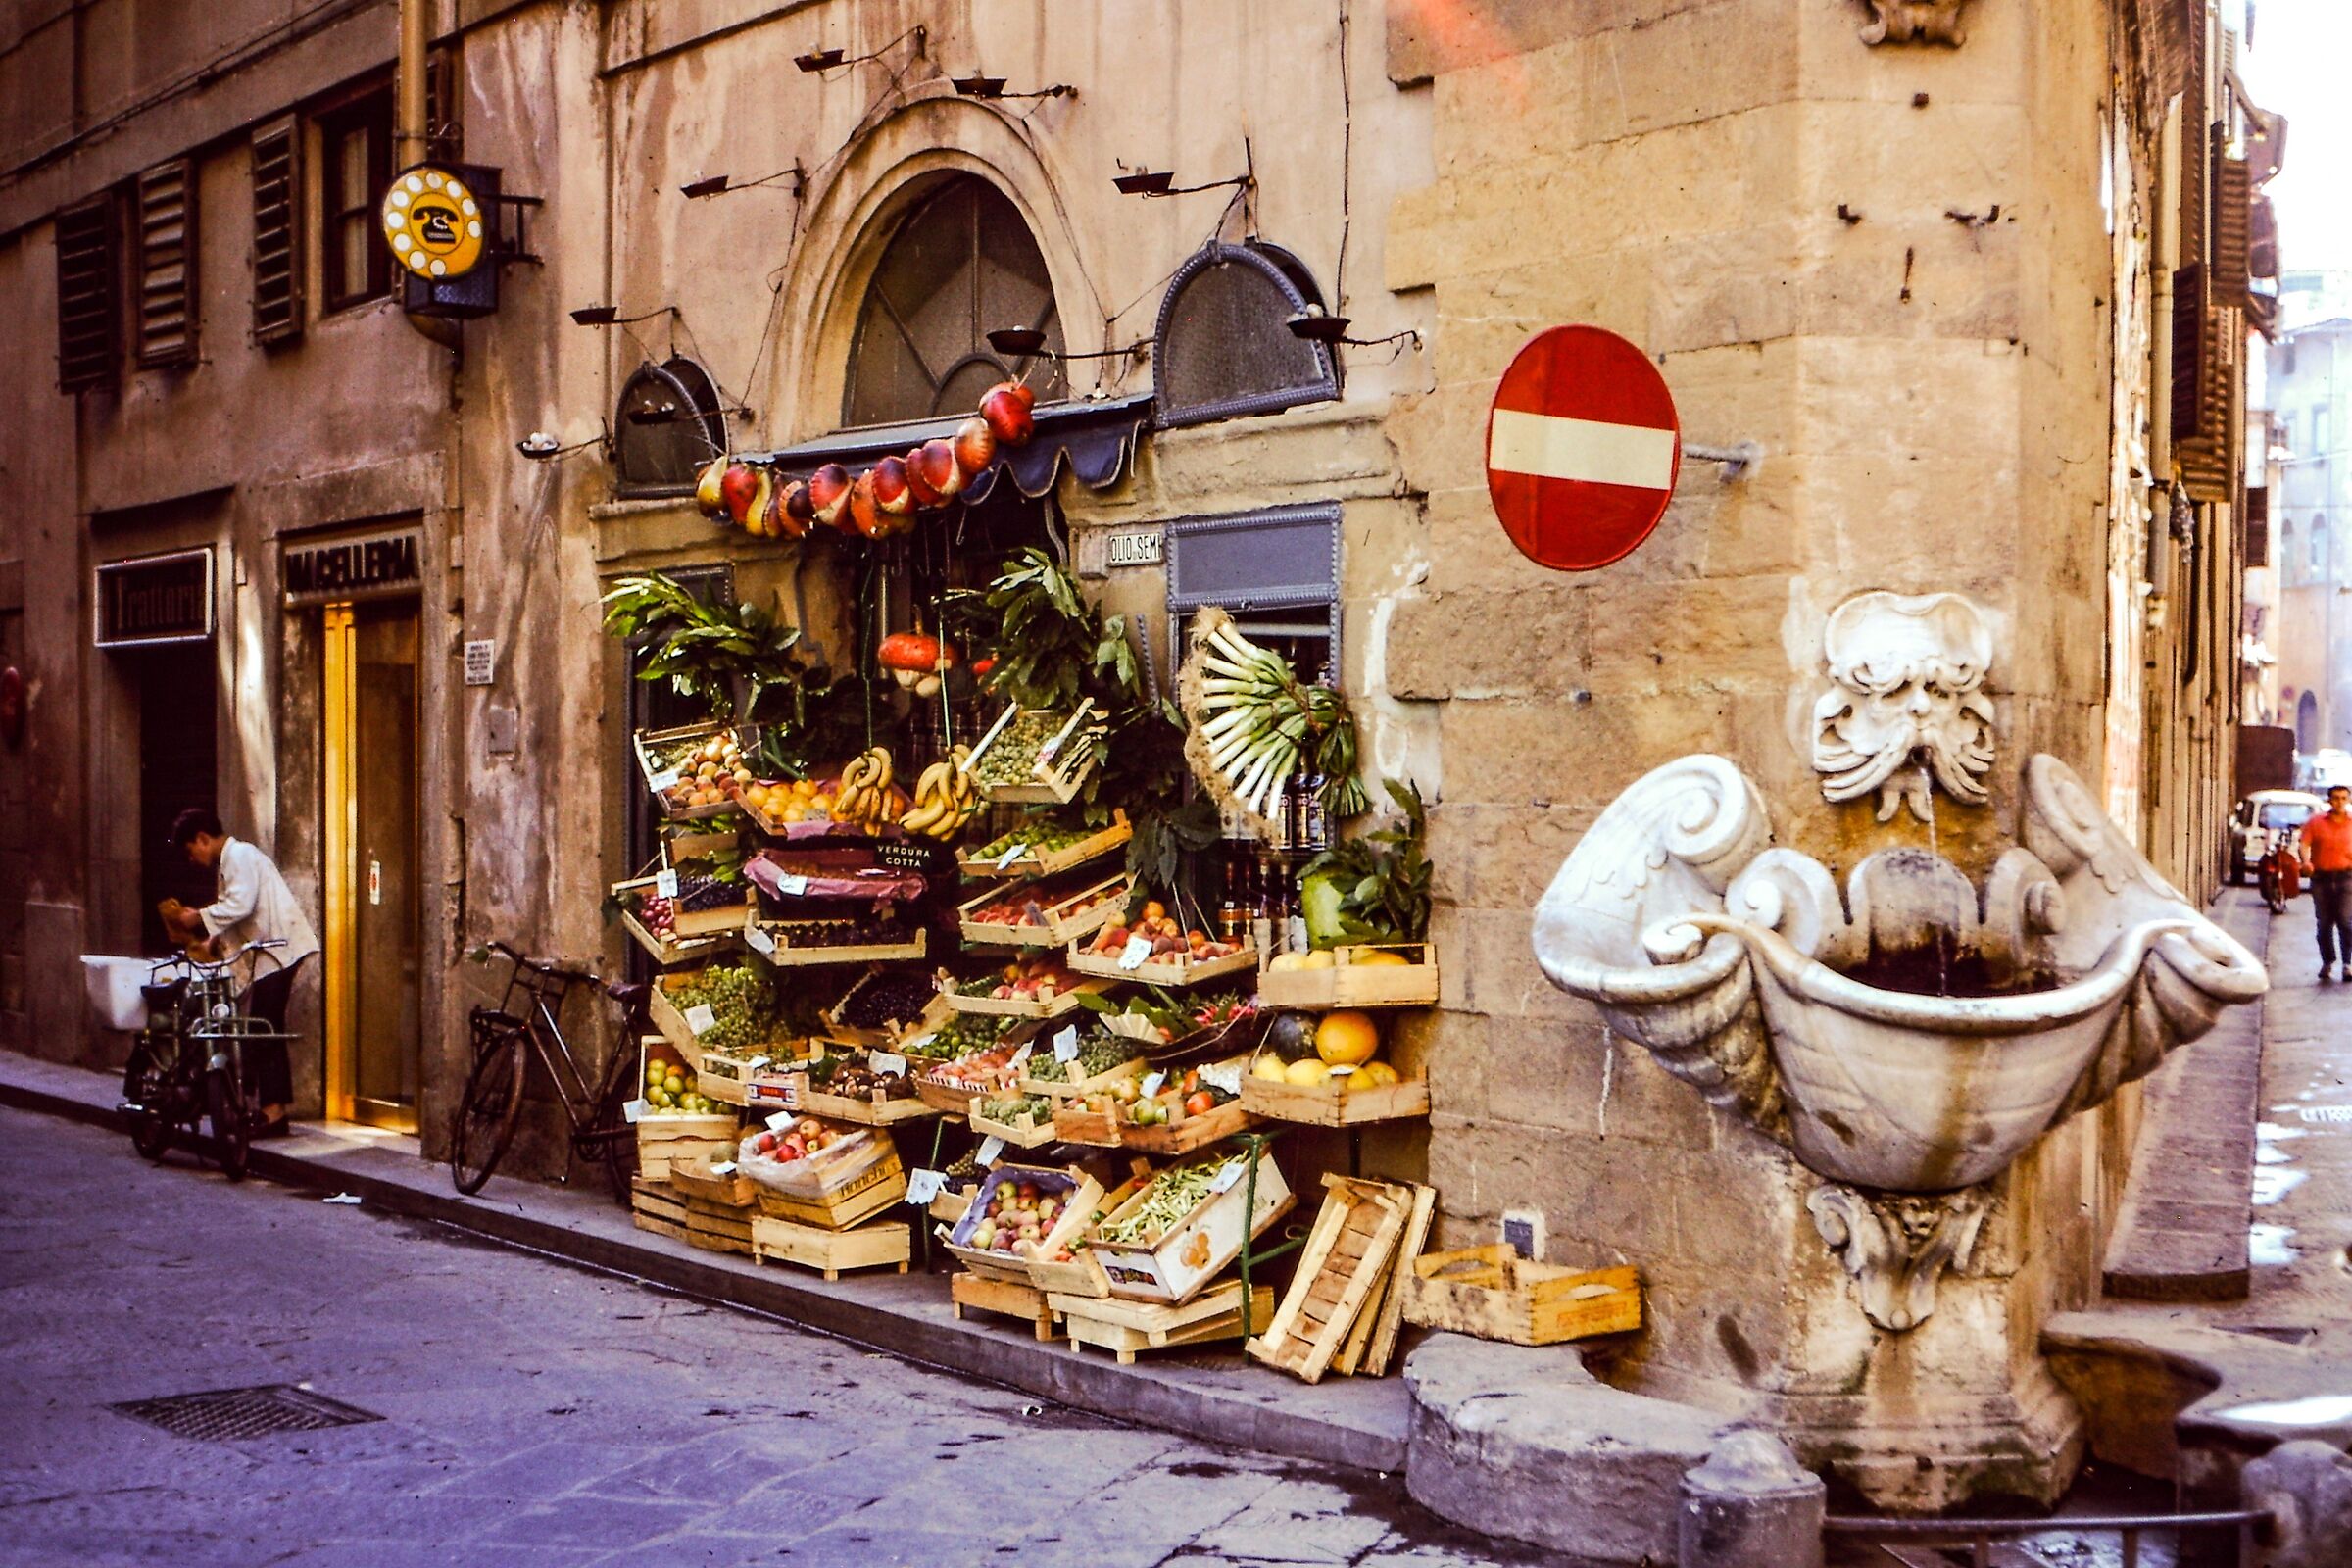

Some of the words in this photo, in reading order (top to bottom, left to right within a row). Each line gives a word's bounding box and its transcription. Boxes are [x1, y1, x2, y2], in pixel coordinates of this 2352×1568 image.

[1111, 537, 1132, 562] OLIO
[877, 845, 930, 858] VERDURA
[886, 857, 921, 868] COTTA
